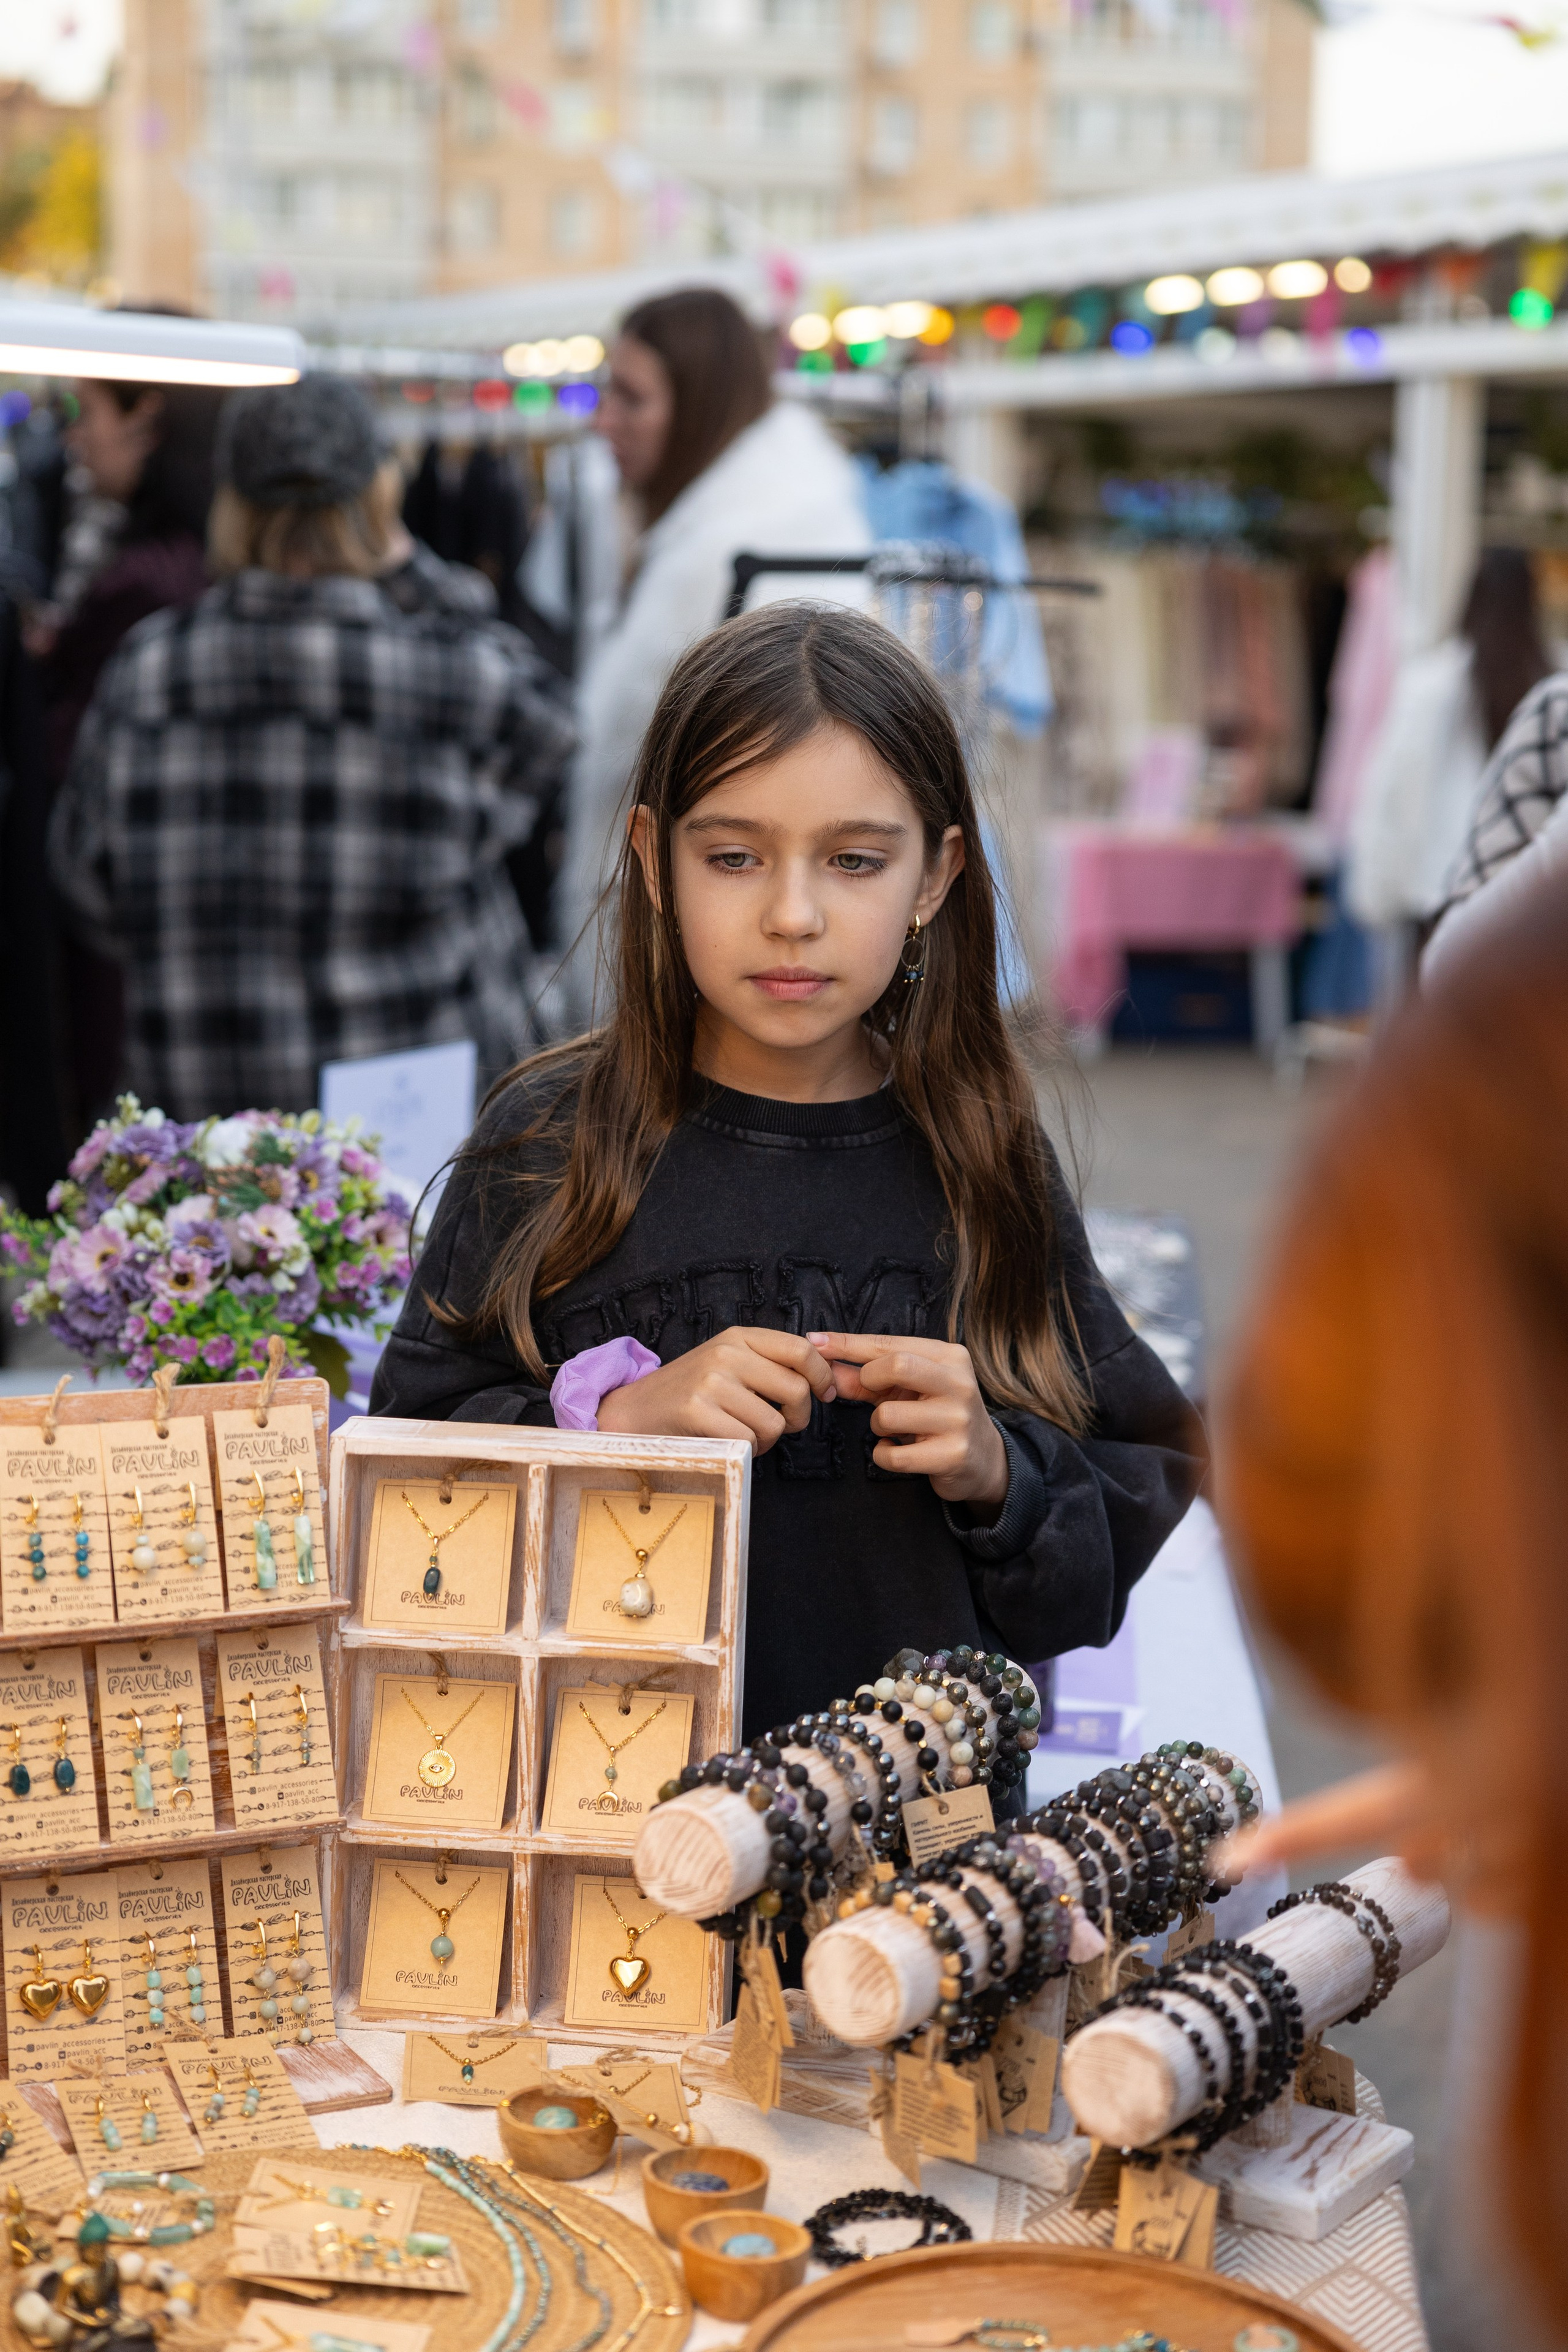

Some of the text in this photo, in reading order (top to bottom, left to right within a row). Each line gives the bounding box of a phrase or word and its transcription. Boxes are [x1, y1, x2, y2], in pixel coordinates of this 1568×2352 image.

[257, 1779, 318, 1793] pavlin_accessories
[284, 1788, 319, 1798] pavlin_acc
[230, 1873, 282, 1886] Дизайнерская мастерская
[254, 1901, 290, 1910] accessories
[143, 1913, 181, 1923] accessories
[39, 1924, 82, 1933] accessories
[36, 2038, 105, 2051] pavlin_accessories
[66, 2047, 106, 2057] pavlin_acc
